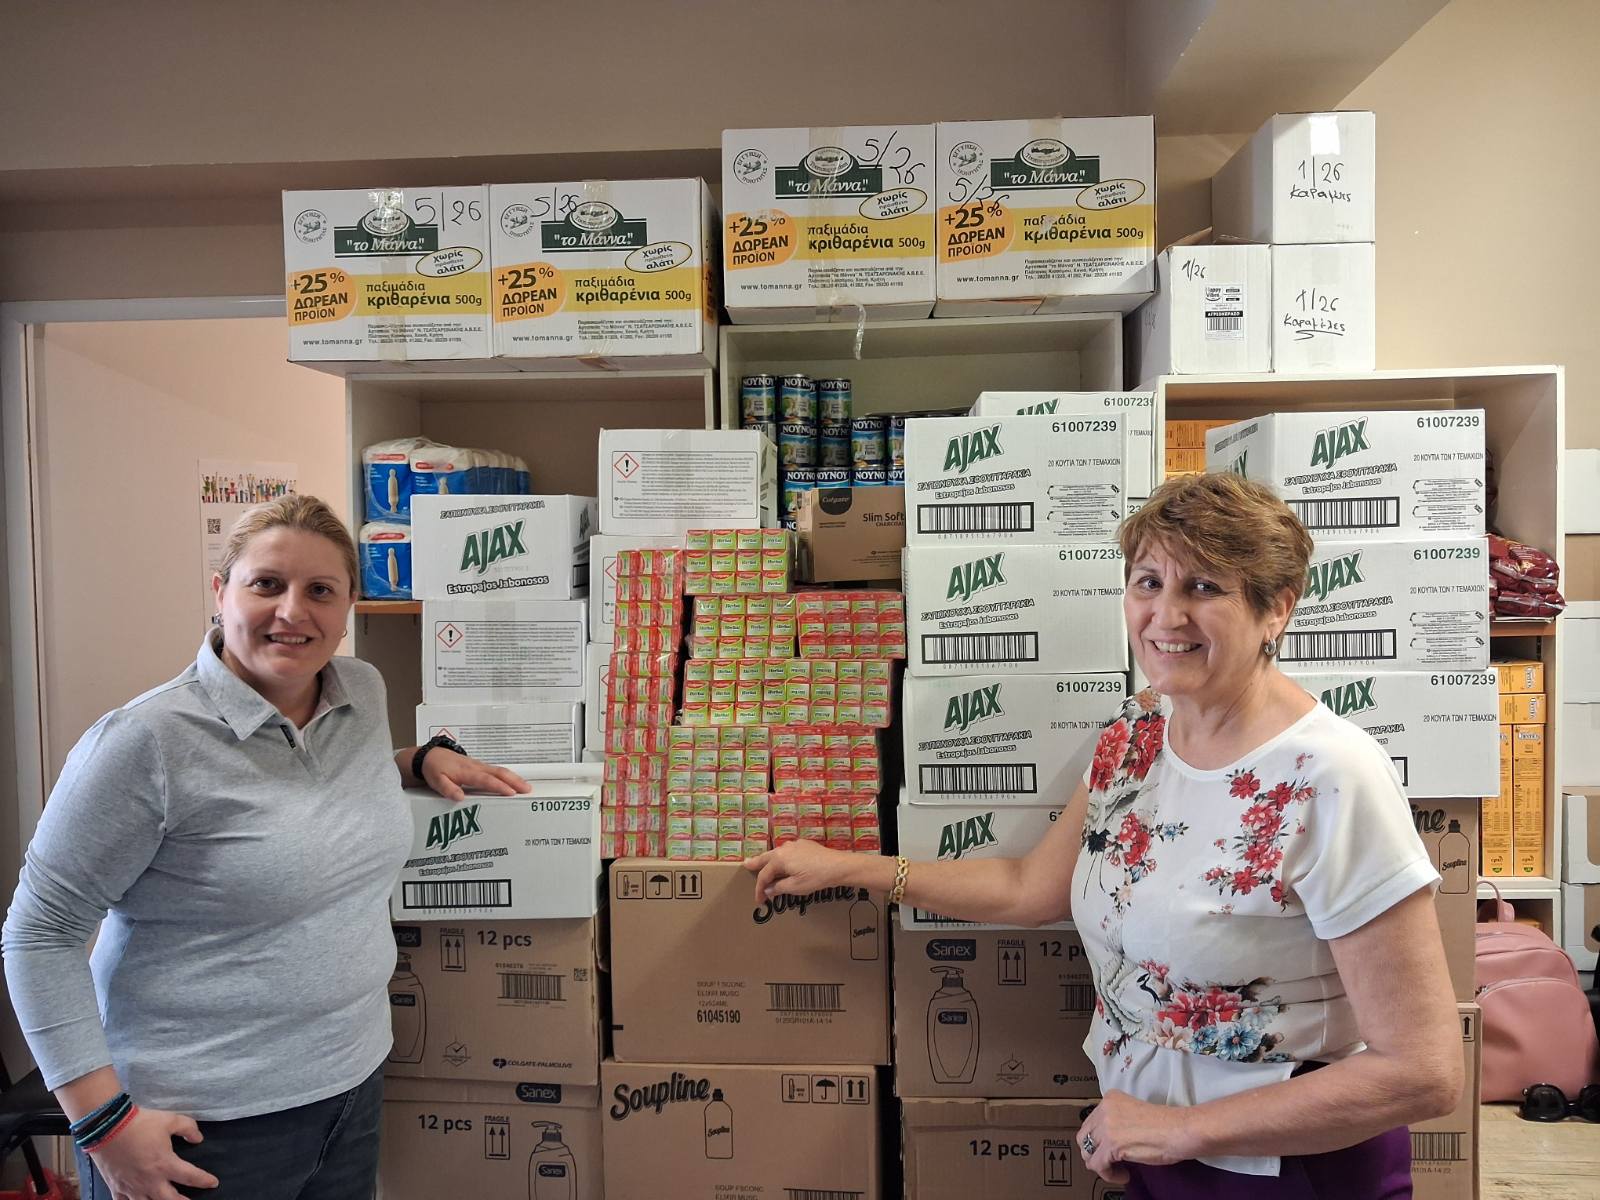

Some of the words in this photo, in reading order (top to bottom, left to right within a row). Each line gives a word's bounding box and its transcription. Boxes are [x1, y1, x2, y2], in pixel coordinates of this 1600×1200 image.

[1094, 182, 1126, 196] χωρίς
[876, 191, 908, 206] χωρίς
[1098, 197, 1127, 208] αλάτι
[880, 206, 910, 218] αλάτι
[808, 223, 869, 237] παξιμάδια
[947, 226, 1006, 246] ΔΩΡΕΑΝ
[1116, 228, 1144, 240] 500g
[732, 235, 789, 254] ΔΩΡΕΑΝ
[808, 234, 894, 253] κριθαρένια
[898, 237, 926, 249] 500g
[433, 249, 464, 264] χωρίς
[642, 244, 672, 259] χωρίς
[436, 264, 466, 275] αλάτι
[646, 259, 675, 270] αλάτι
[575, 276, 635, 291] παξιμάδια
[956, 274, 1020, 283] www.tomanna.gr
[366, 281, 426, 296] παξιμάδια
[740, 283, 803, 291] www.tomanna.gr
[294, 292, 348, 310] ΔΩΡΕΑΝ
[367, 291, 451, 309] κριθαρένια
[455, 295, 482, 306] 500g
[502, 288, 558, 306] ΔΩΡΕΑΝ
[576, 287, 661, 305] κριθαρένια
[665, 291, 692, 302] 500g
[303, 337, 363, 346] www.tomanna.gr
[1052, 420, 1117, 432] 61007239
[1416, 416, 1480, 428] 61007239
[943, 423, 1004, 473] AJAX
[1310, 416, 1372, 470] AJAX
[934, 487, 974, 500] Estropajos
[975, 482, 1016, 496] Jabonosos
[1302, 482, 1342, 495] Estropajos
[1342, 477, 1382, 490] Jabonosos
[863, 513, 883, 522] Slim
[885, 511, 905, 522] Soft
[460, 518, 530, 576] AJAX
[1413, 548, 1480, 560] 61007239
[1059, 550, 1123, 560] 61007239
[447, 580, 498, 594] Estropajos
[499, 575, 550, 589] Jabonosos
[946, 552, 1007, 604] AJAX
[939, 618, 978, 630] Estropajos
[978, 612, 1019, 625] Jabonosos
[1294, 617, 1336, 628] Estropajos
[1336, 610, 1377, 622] Jabonosos
[1056, 682, 1122, 693] 61007239
[1430, 674, 1496, 686] 61007239
[943, 682, 1005, 735] AJAX
[936, 749, 976, 760] Estropajos
[976, 744, 1017, 756] Jabonosos
[530, 800, 591, 812] 61007239
[425, 803, 483, 853] AJAX
[1442, 860, 1468, 872] Soupline
[397, 930, 417, 943] nex
[477, 930, 498, 946] 12
[503, 934, 532, 950] pcs
[931, 942, 972, 958] Sanex
[1040, 941, 1062, 957] 12
[696, 1010, 741, 1024] 61045190
[521, 1085, 557, 1099] Sanex
[610, 1072, 711, 1121] Soupline
[418, 1114, 438, 1130] 12
[444, 1118, 472, 1134] pcs
[970, 1140, 992, 1156] 12
[998, 1144, 1030, 1160] pcs
